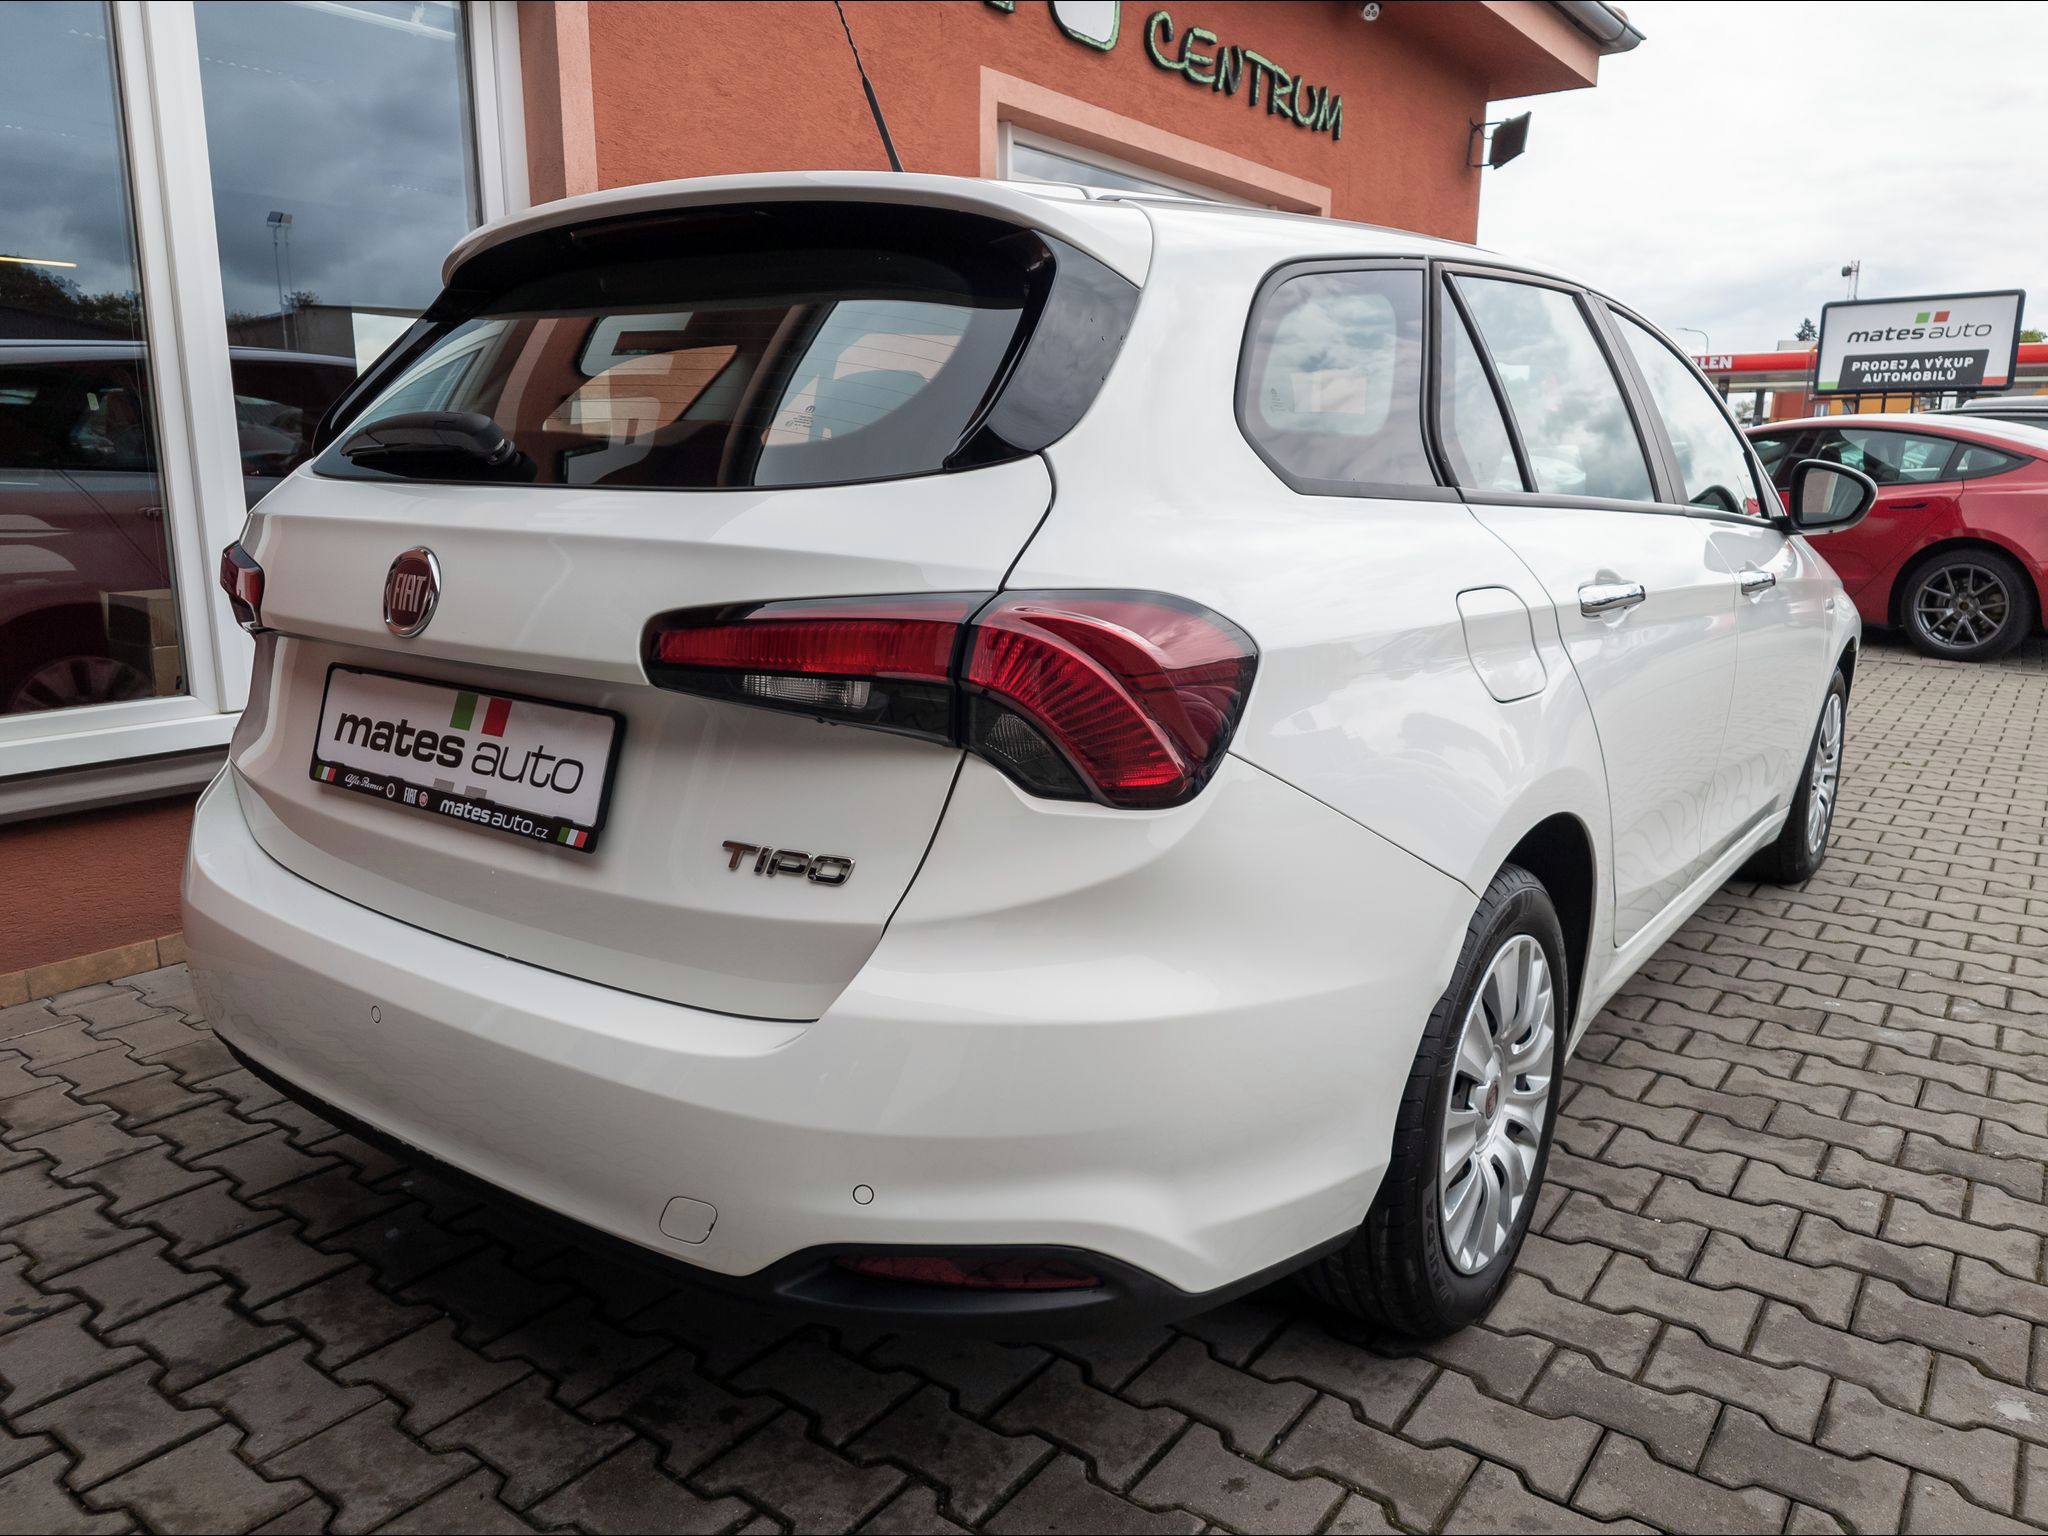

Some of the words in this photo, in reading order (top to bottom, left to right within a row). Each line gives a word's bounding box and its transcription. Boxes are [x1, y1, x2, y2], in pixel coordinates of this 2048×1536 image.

[1143, 10, 1344, 142] CENTRUM
[1847, 326, 1926, 344] mates
[1928, 322, 1992, 340] auto
[1691, 355, 1733, 370] LEN
[1851, 359, 1909, 372] PRODEJ
[1910, 360, 1921, 371] A
[1924, 355, 1975, 370] VÝKUP
[391, 572, 428, 613] FIAT
[334, 712, 466, 769] mates
[471, 741, 585, 795] auto
[344, 773, 361, 788] Alfa
[360, 776, 385, 792] Romeo
[403, 786, 419, 805] FIAT
[721, 839, 857, 888] TIPO
